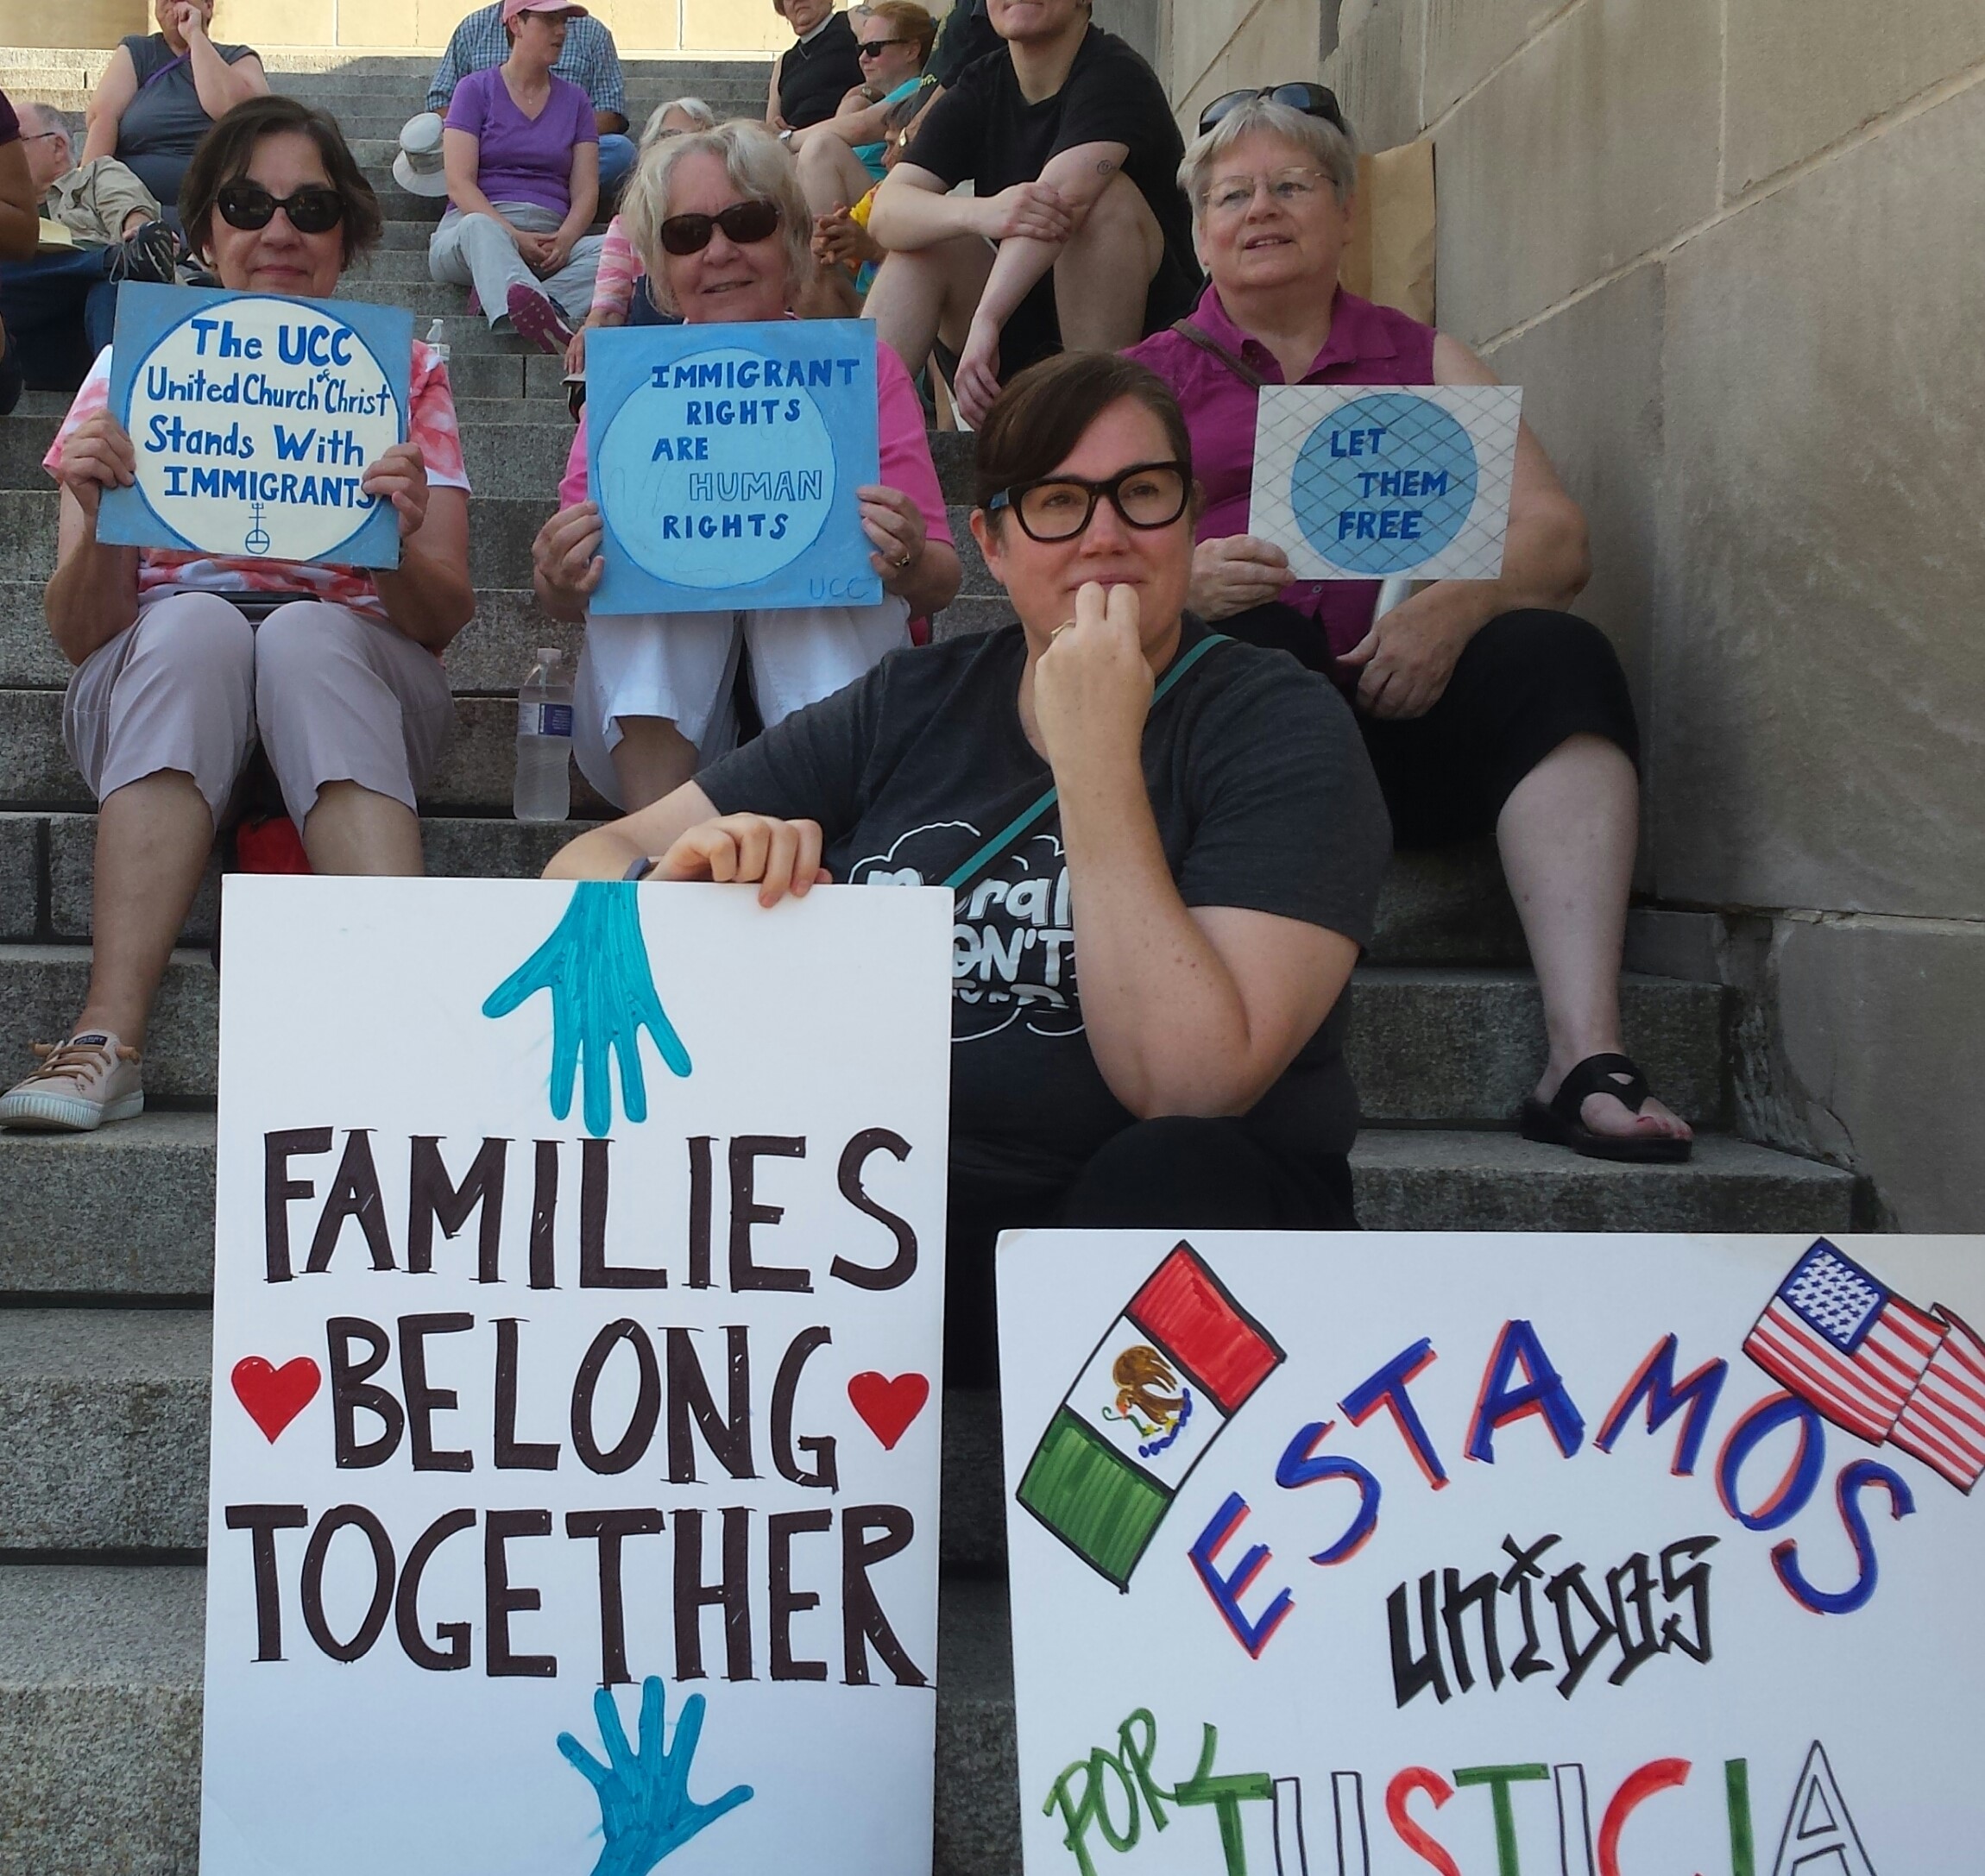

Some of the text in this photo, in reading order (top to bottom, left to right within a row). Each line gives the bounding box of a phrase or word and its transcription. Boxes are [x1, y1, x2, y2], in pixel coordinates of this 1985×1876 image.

[191, 318, 353, 367] The UCC
[651, 358, 860, 389] IMMIGRANT
[147, 365, 240, 403] United
[243, 373, 319, 411] Church
[324, 378, 391, 416] Christ
[686, 399, 801, 425] RIGHTS
[144, 414, 364, 468] Stands With
[651, 437, 709, 462] ARE
[1330, 428, 1387, 457] LET
[690, 469, 822, 502] HUMAN
[1357, 470, 1448, 498] THEM
[662, 513, 789, 539] RIGHTS
[1338, 511, 1423, 540] FREE
[810, 577, 869, 600] UCC
[262, 1125, 917, 1293] FAMILIES
[325, 1312, 840, 1495] BELONG
[1188, 1319, 1918, 1660] ESTAMOS
[224, 1503, 938, 1691] TOGETHER
[1042, 1707, 1175, 1876] POR
